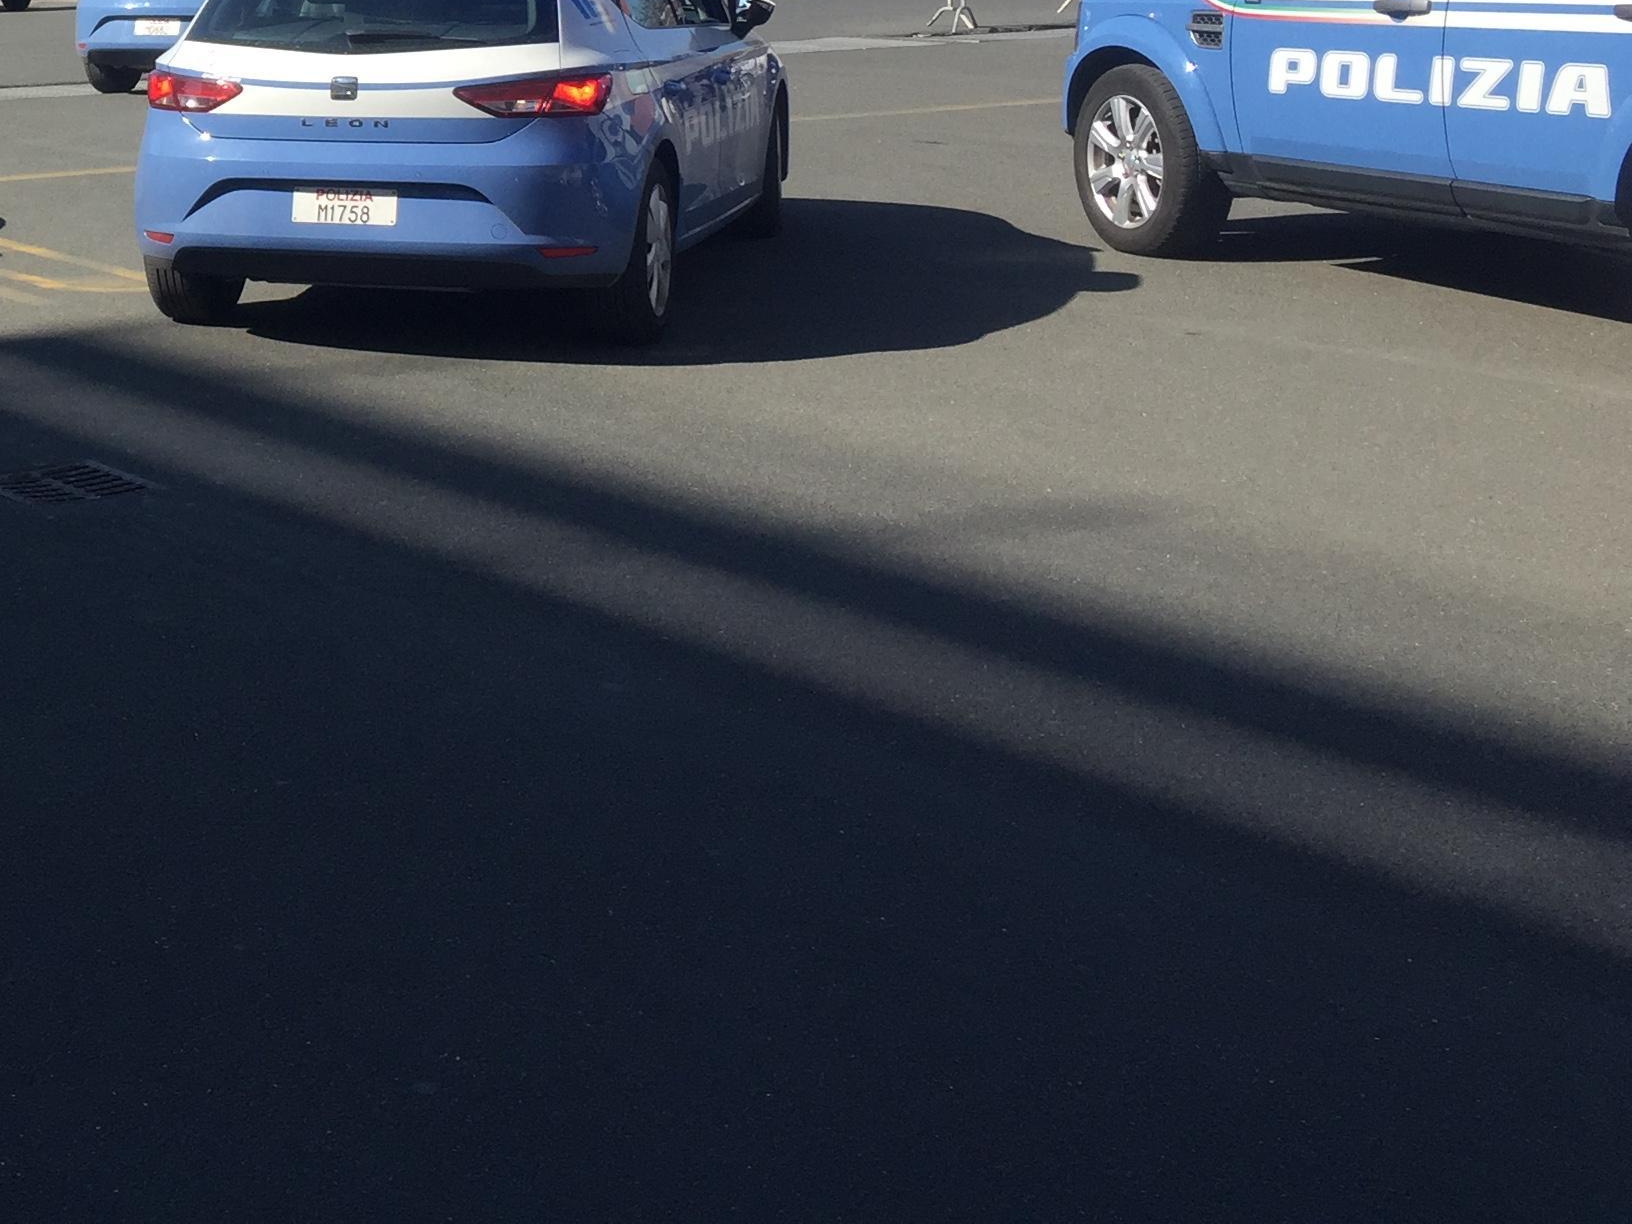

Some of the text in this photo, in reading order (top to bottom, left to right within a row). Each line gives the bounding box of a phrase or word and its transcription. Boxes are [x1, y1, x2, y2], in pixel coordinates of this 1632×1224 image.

[1268, 48, 1611, 119] POLIZIA
[301, 119, 389, 129] LEON
[316, 189, 373, 202] POLIZIA
[317, 204, 370, 223] M1758
